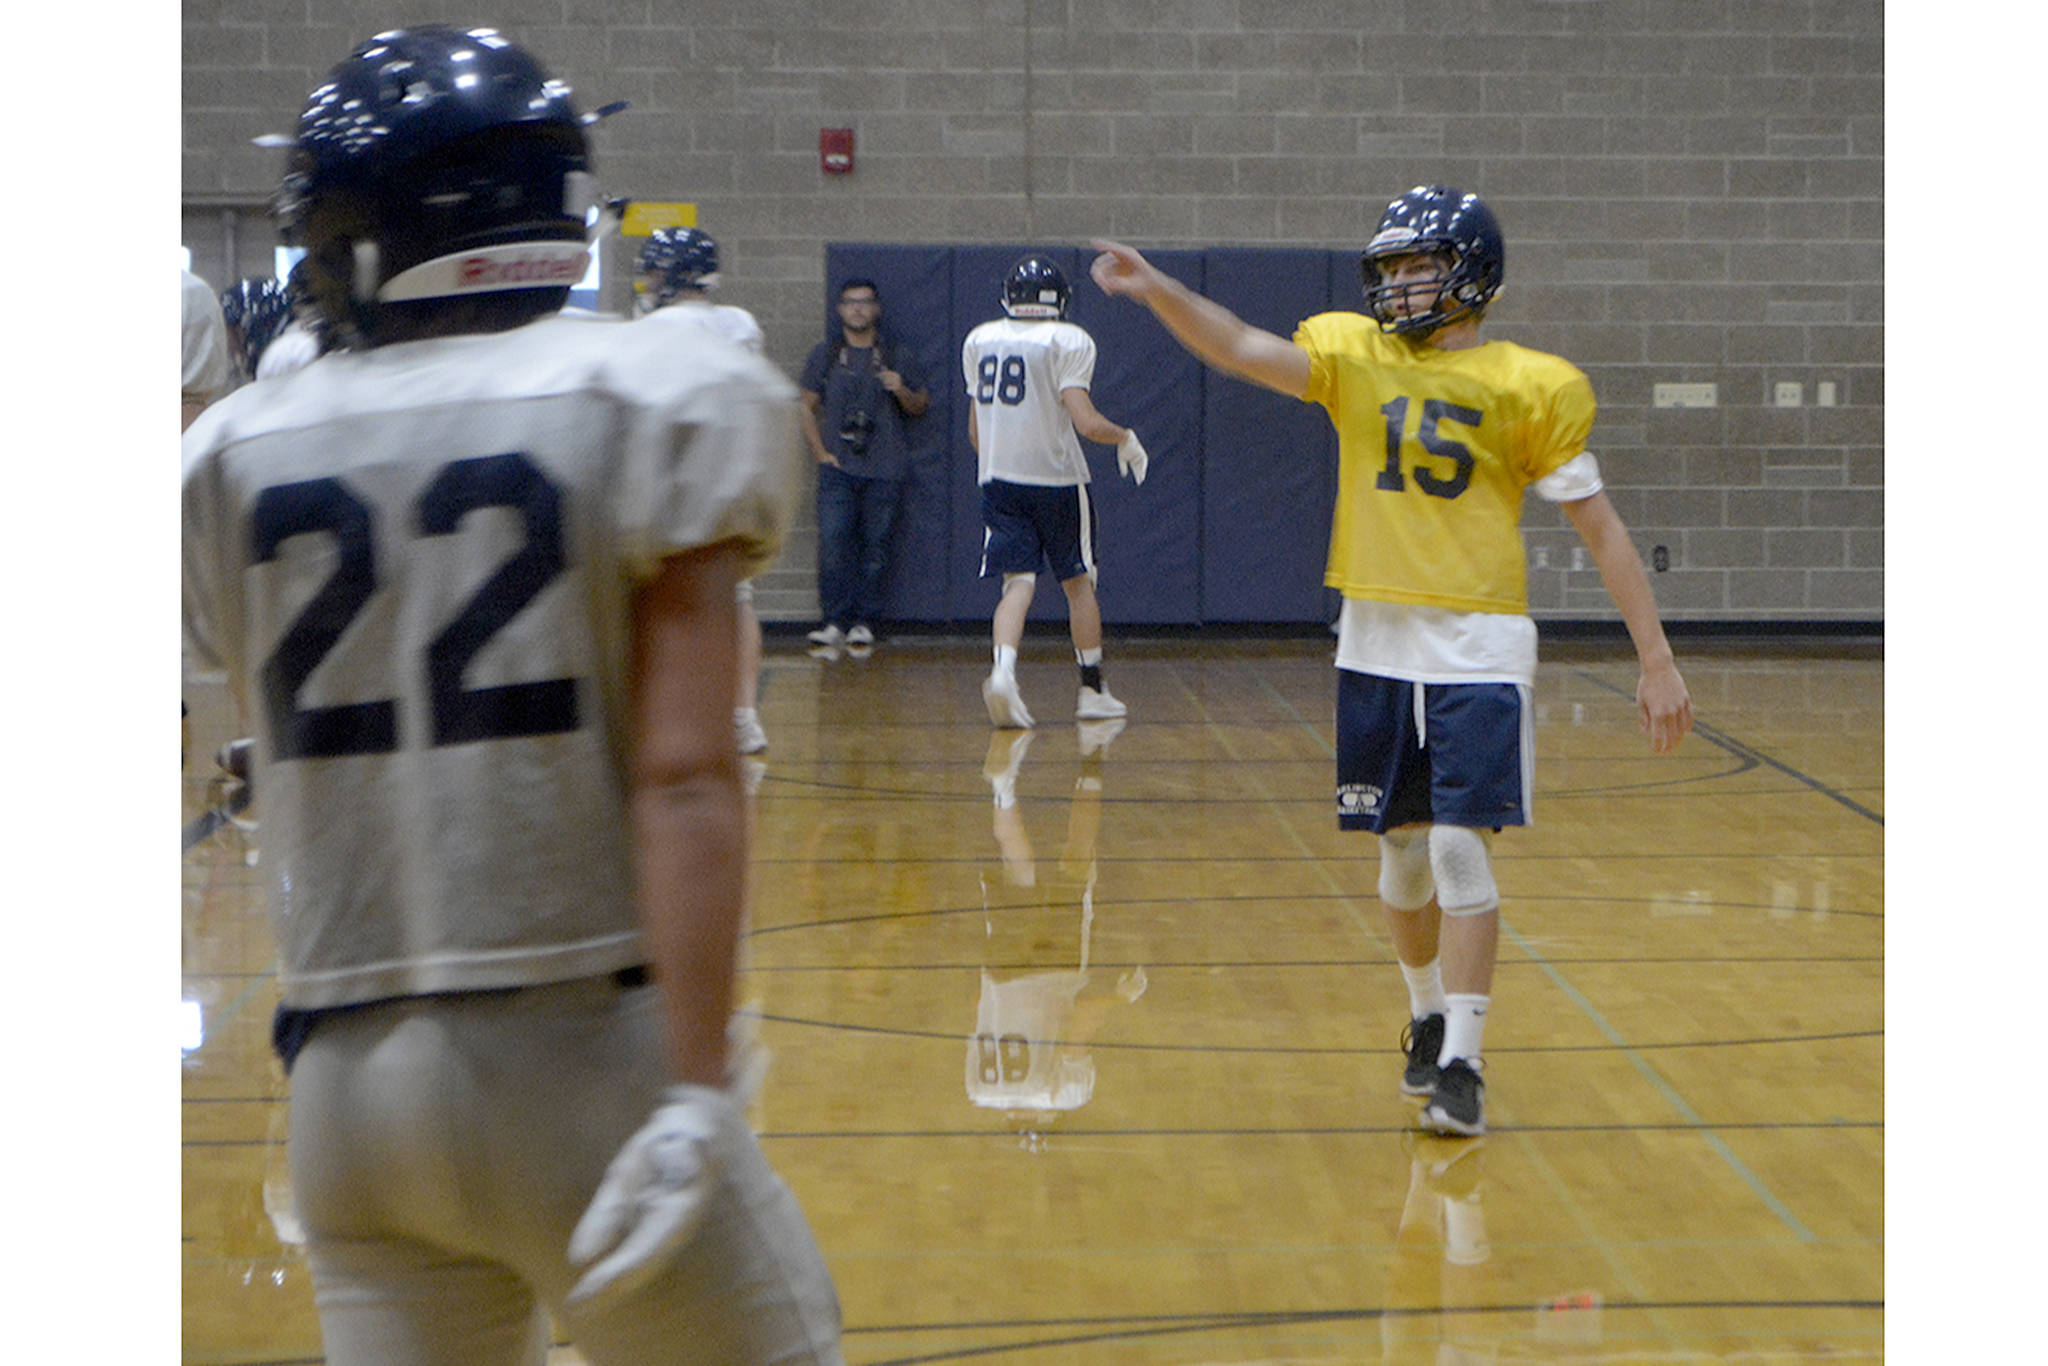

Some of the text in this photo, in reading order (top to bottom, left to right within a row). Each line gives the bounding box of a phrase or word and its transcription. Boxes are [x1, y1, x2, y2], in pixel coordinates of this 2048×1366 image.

[977, 354, 1025, 406] 88
[1375, 395, 1483, 500] 15
[249, 450, 578, 763] 22
